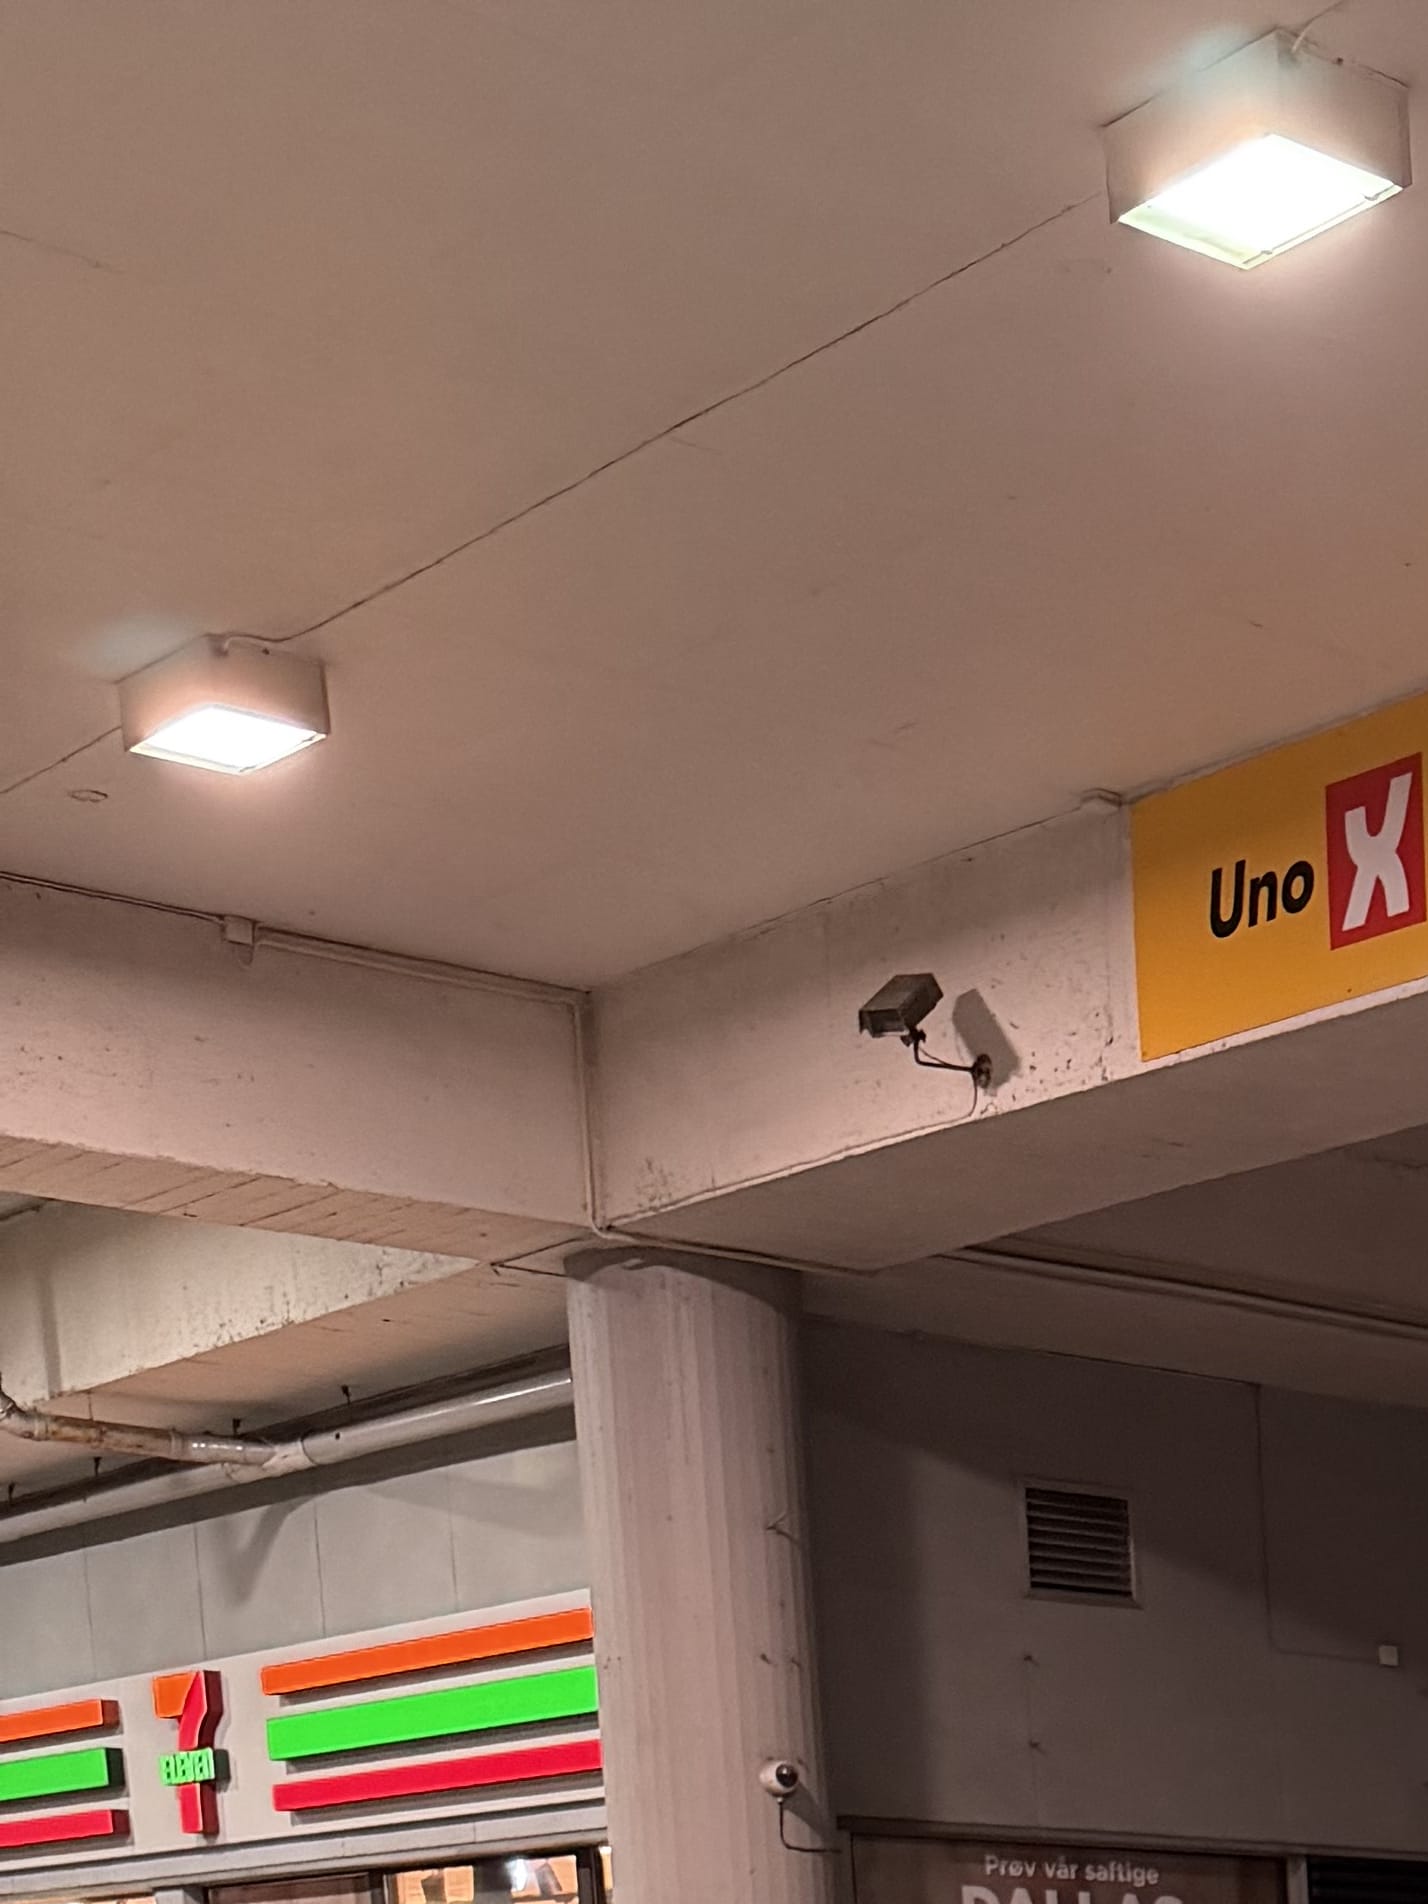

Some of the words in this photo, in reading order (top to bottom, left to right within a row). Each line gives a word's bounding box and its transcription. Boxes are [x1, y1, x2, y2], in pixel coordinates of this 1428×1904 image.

[1209, 857, 1314, 939] Uno
[1342, 772, 1412, 931] X
[153, 1669, 207, 1834] 7
[985, 1855, 1035, 1877] Prøv
[1044, 1856, 1079, 1880] vår
[1085, 1861, 1159, 1887] saftige
